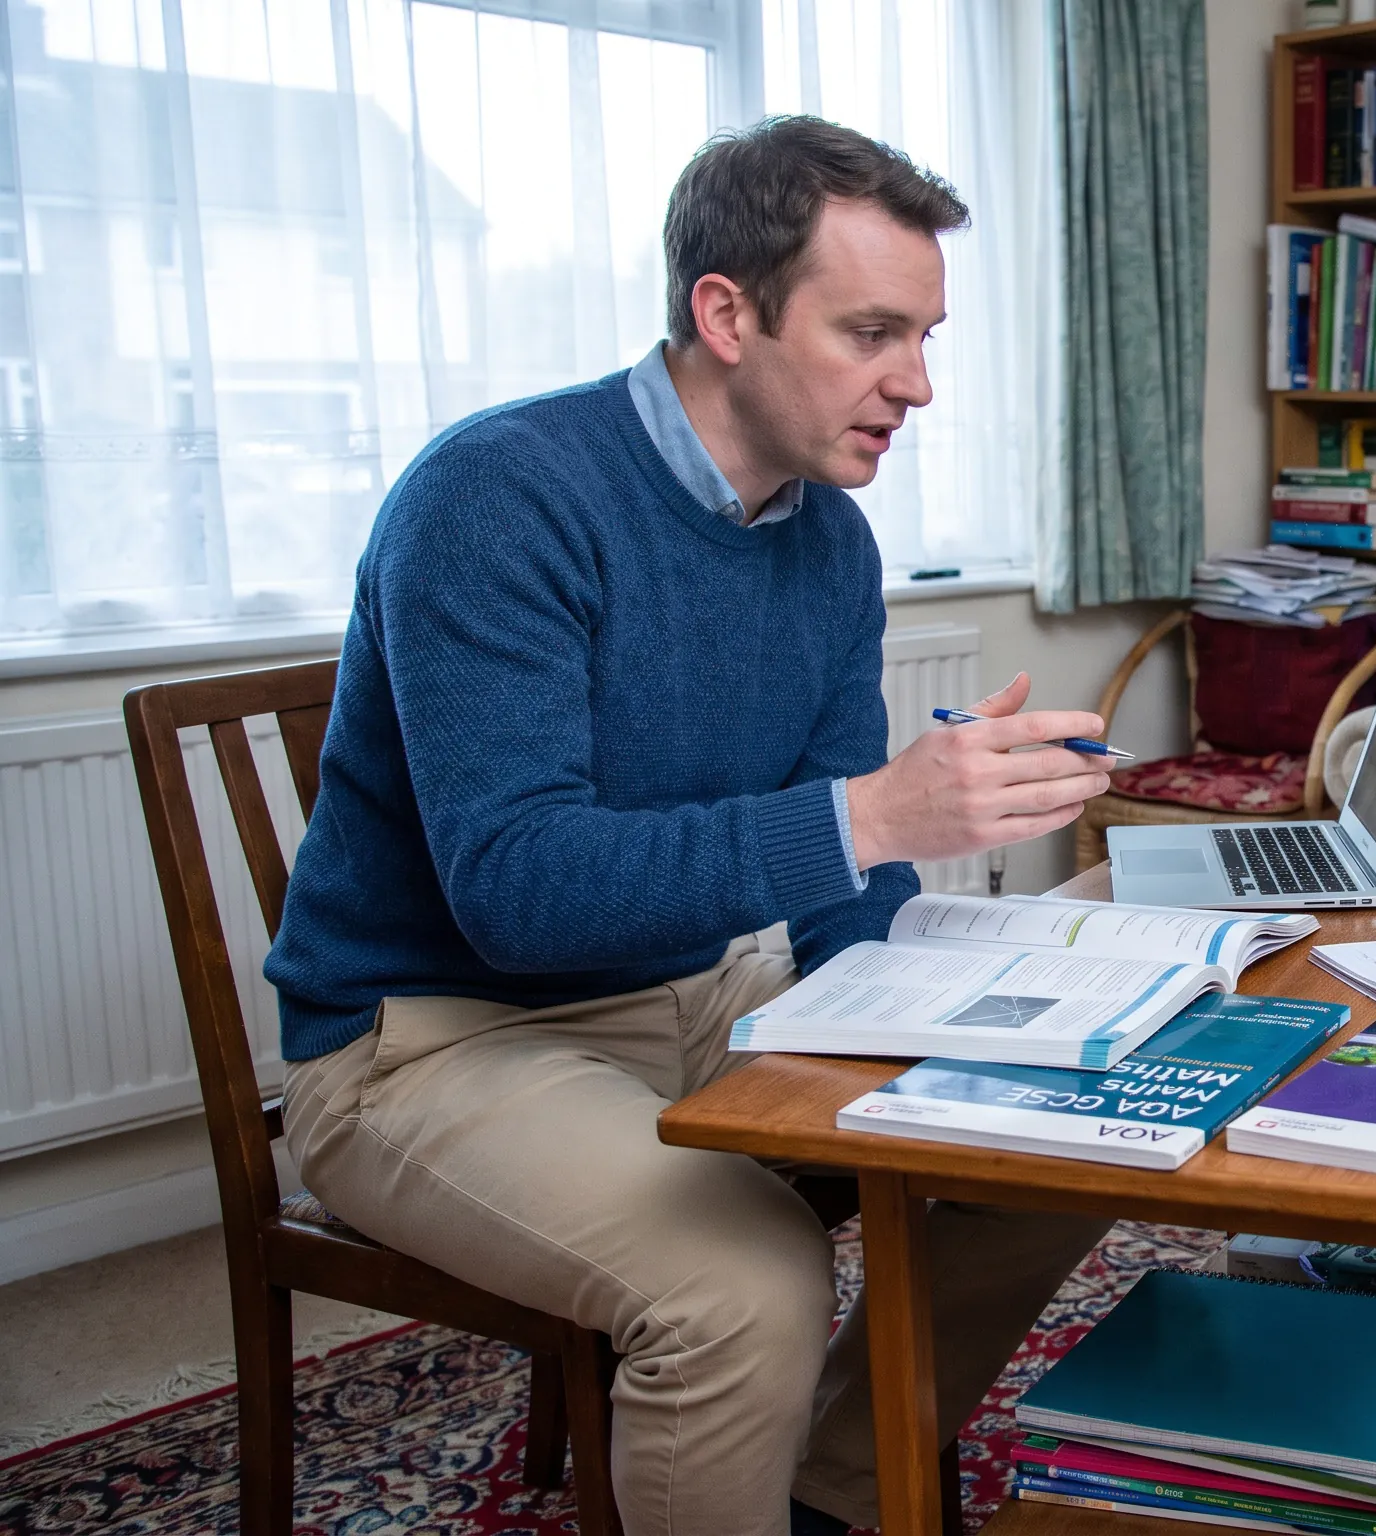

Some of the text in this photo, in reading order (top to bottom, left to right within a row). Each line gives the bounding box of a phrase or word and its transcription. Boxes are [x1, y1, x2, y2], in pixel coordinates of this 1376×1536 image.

[1110, 1061, 1242, 1087] Maths
[997, 1087, 1105, 1110] GCSE
[1098, 1124, 1177, 1142] AQA
